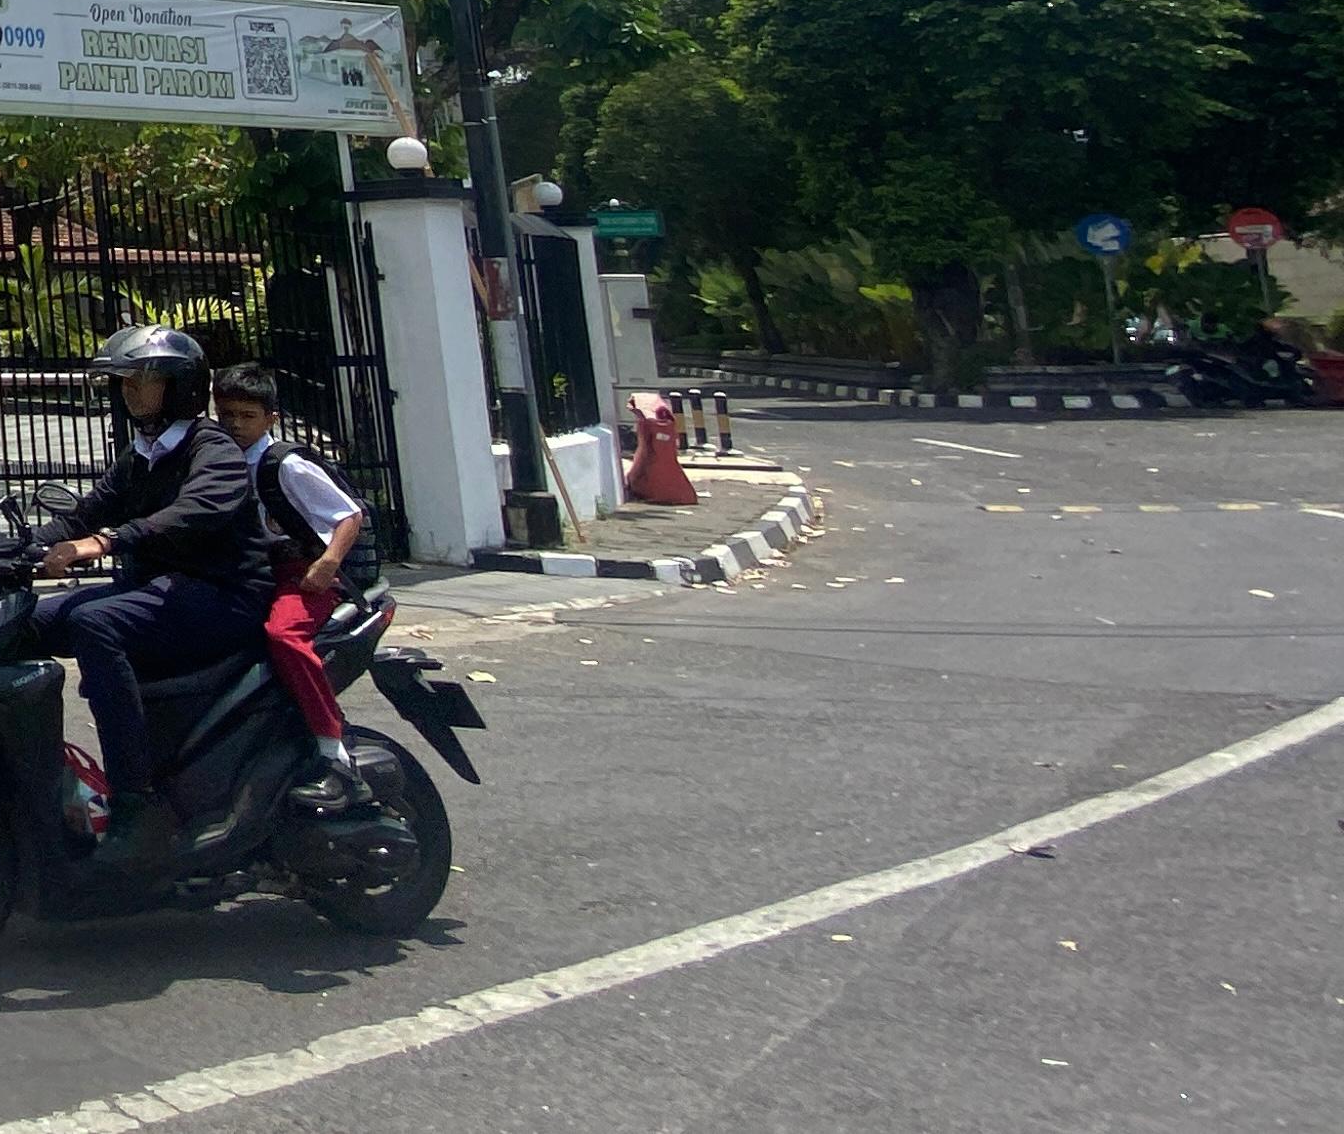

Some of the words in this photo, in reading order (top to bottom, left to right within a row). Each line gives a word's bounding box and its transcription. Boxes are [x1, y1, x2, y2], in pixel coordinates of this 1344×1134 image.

[89, 3, 125, 25] Open
[128, 3, 193, 27] Donation
[81, 28, 207, 64] RENOVASI
[58, 61, 139, 94] PANTI
[143, 66, 236, 100] PAROKI
